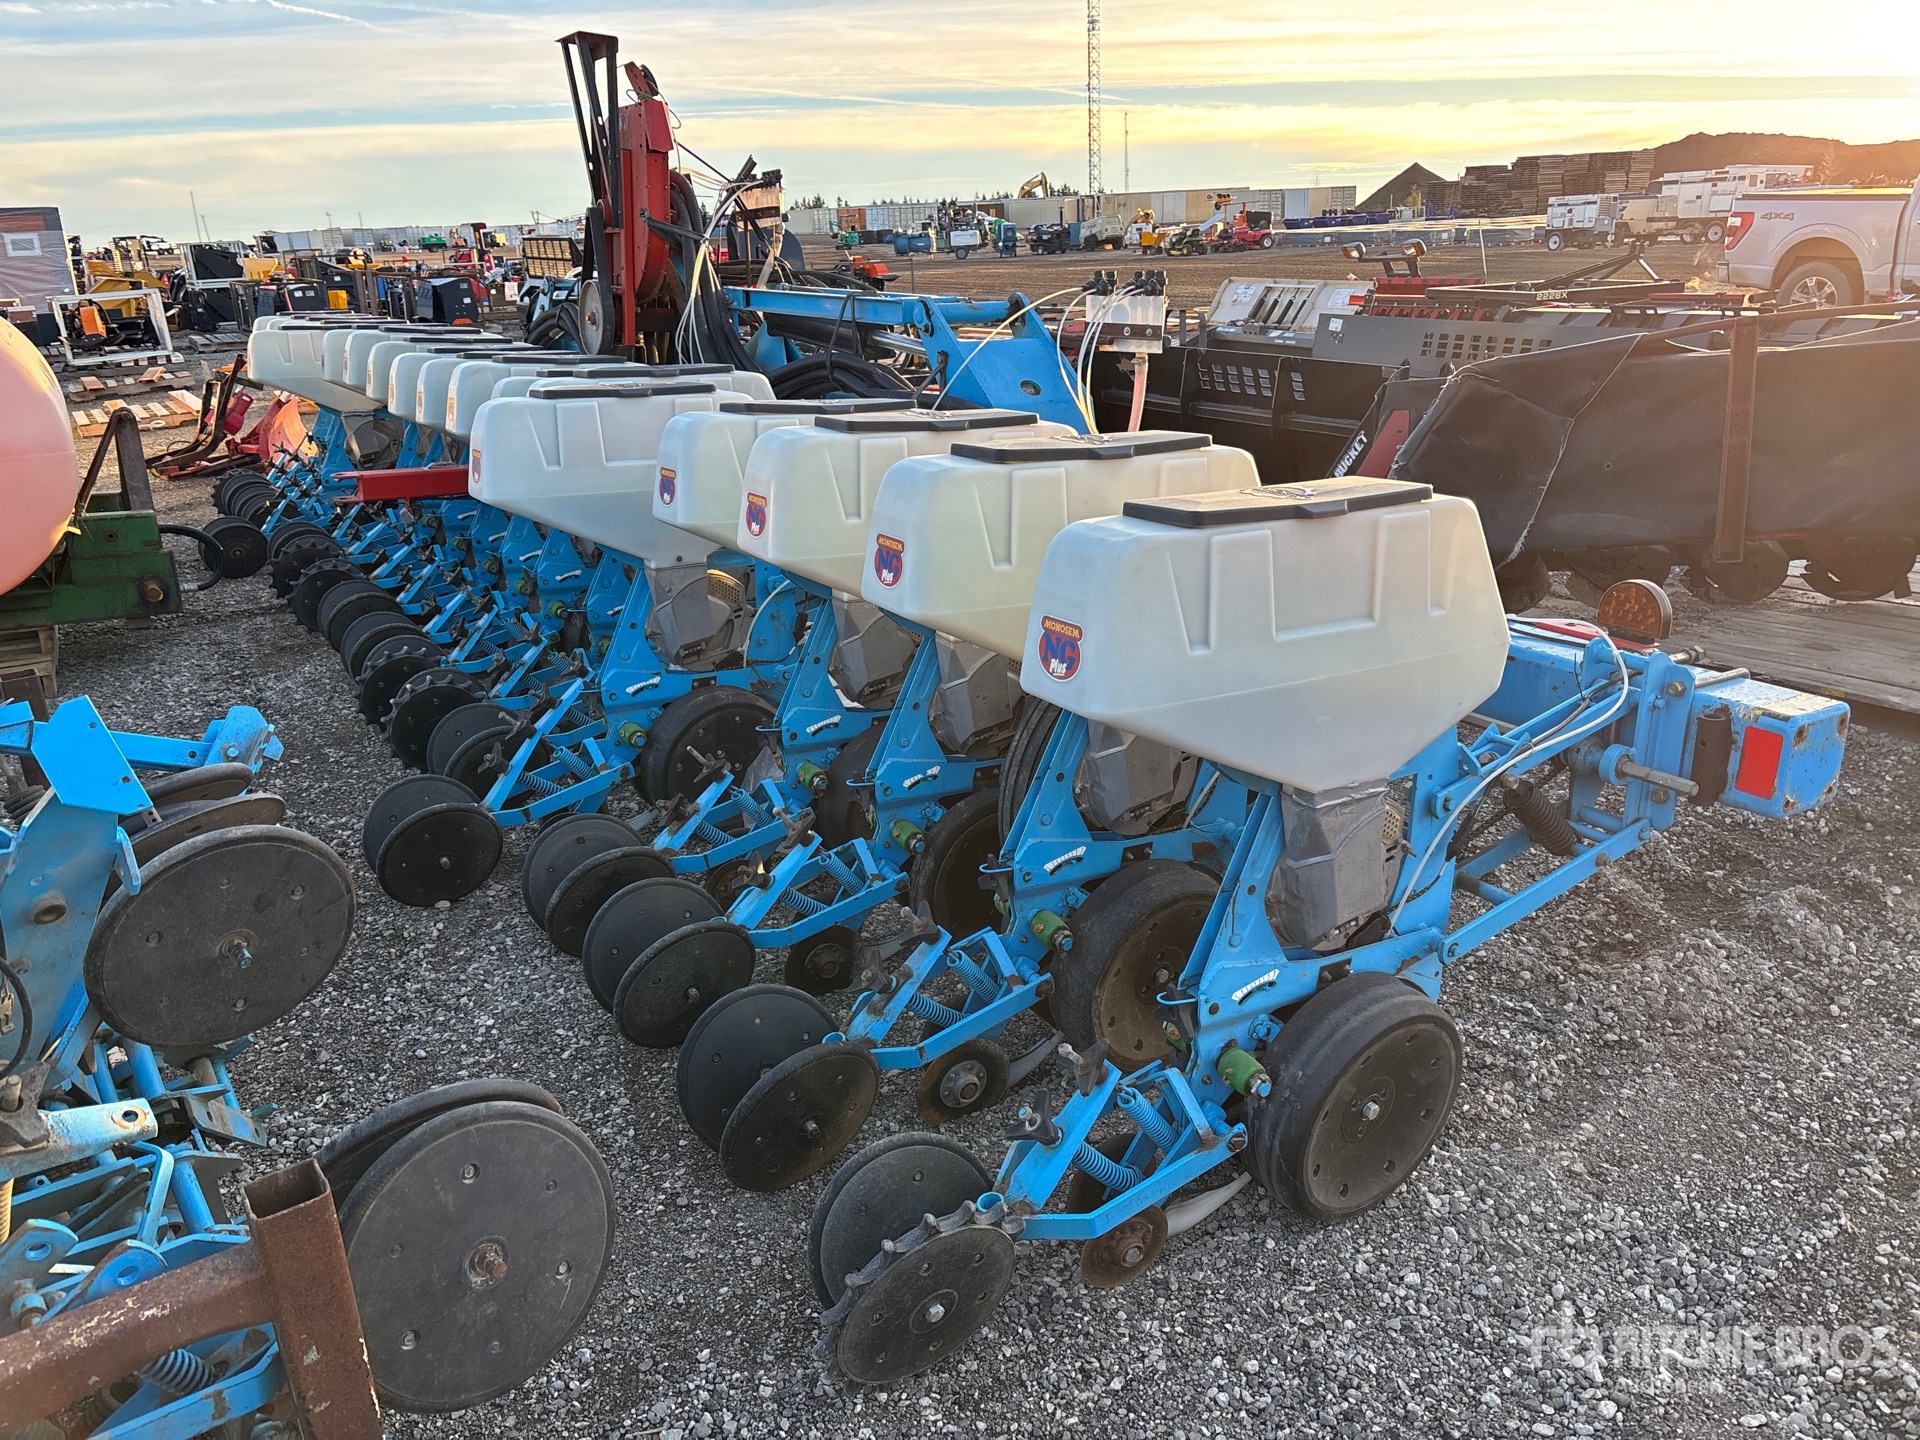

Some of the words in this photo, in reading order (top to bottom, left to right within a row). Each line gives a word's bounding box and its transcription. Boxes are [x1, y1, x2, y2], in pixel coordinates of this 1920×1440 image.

[1536, 291, 1568, 301] 2228X
[1333, 430, 1368, 477] BUCKET
[1043, 619, 1080, 639] MONOSEM
[1043, 633, 1076, 670] NG
[1049, 658, 1067, 674] Plus
